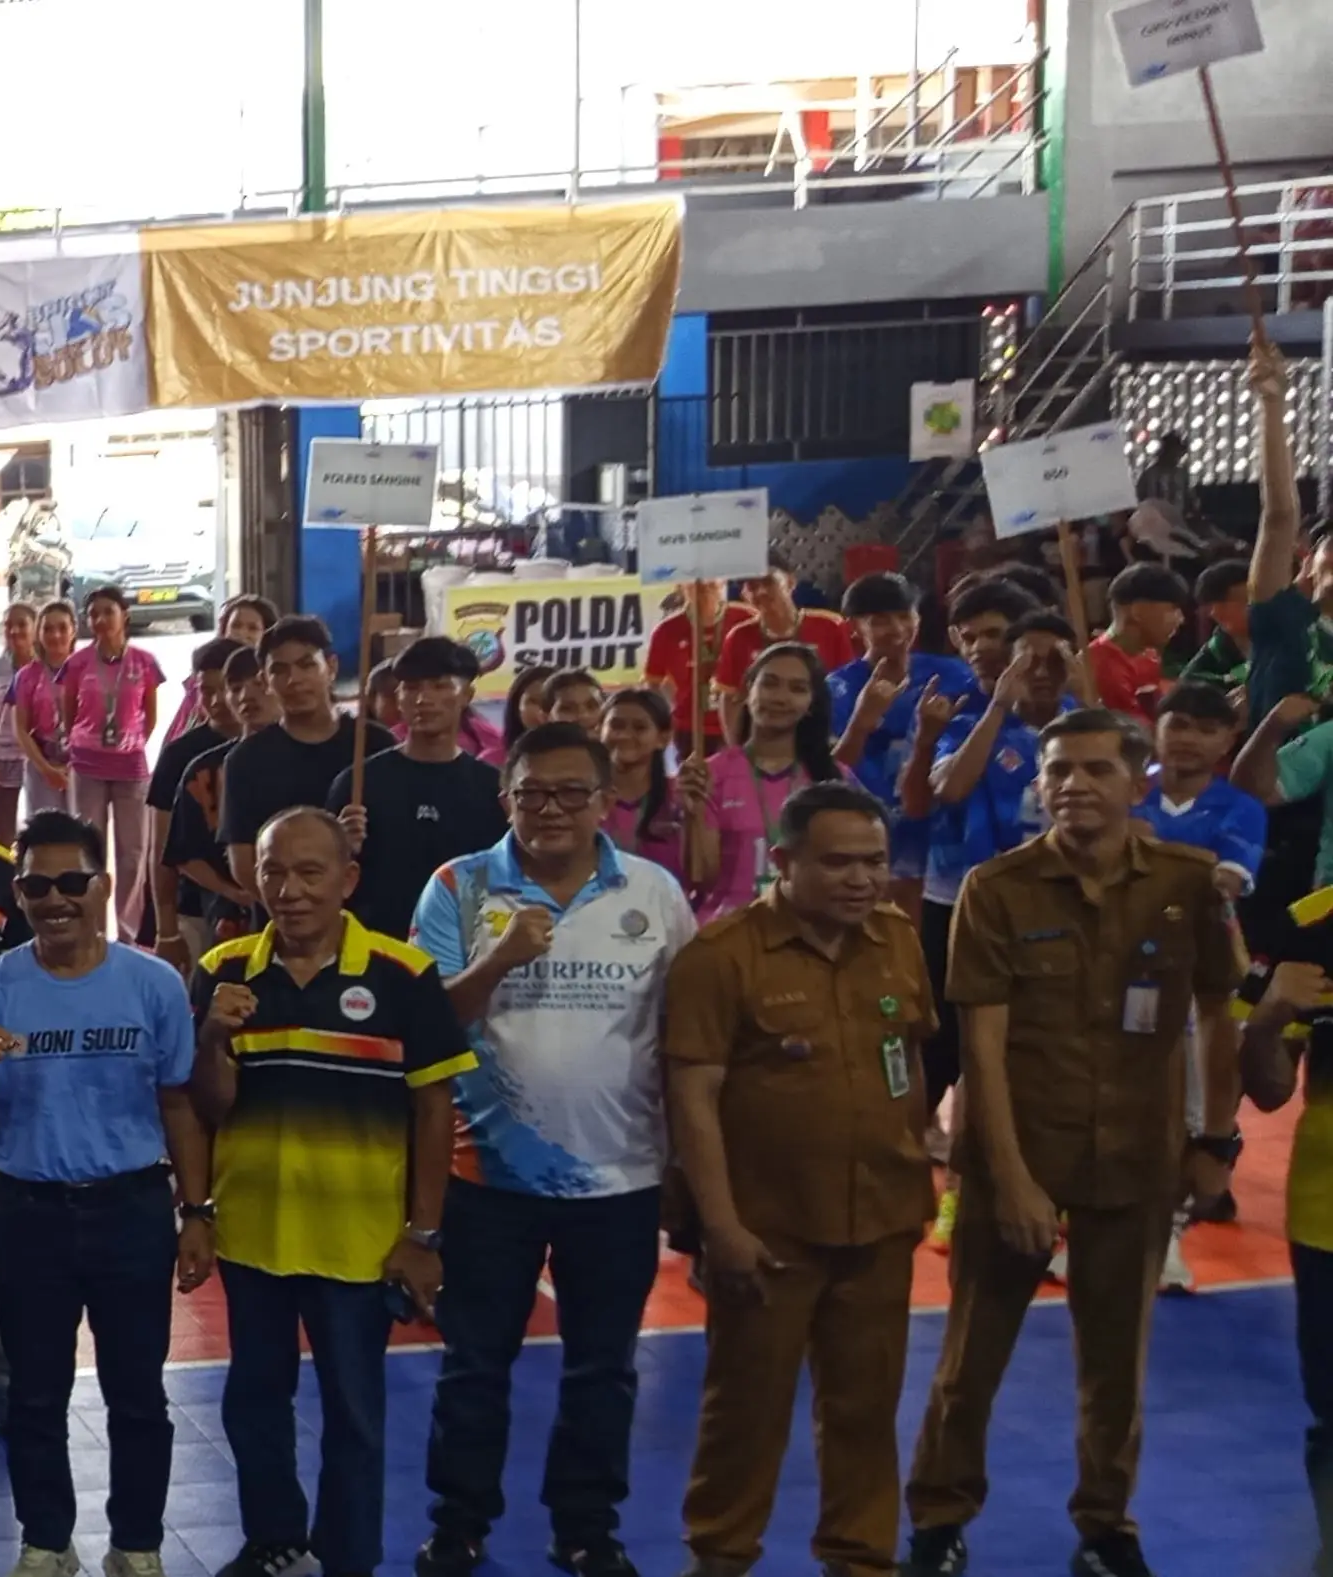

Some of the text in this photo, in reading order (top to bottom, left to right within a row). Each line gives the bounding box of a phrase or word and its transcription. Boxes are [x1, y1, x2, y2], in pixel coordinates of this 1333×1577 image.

[228, 262, 601, 312] JUNJUNG TINGGI
[267, 315, 564, 362] SPORTIVITAS
[514, 593, 644, 644] POLDA
[27, 1027, 141, 1054] KONI SULUT
